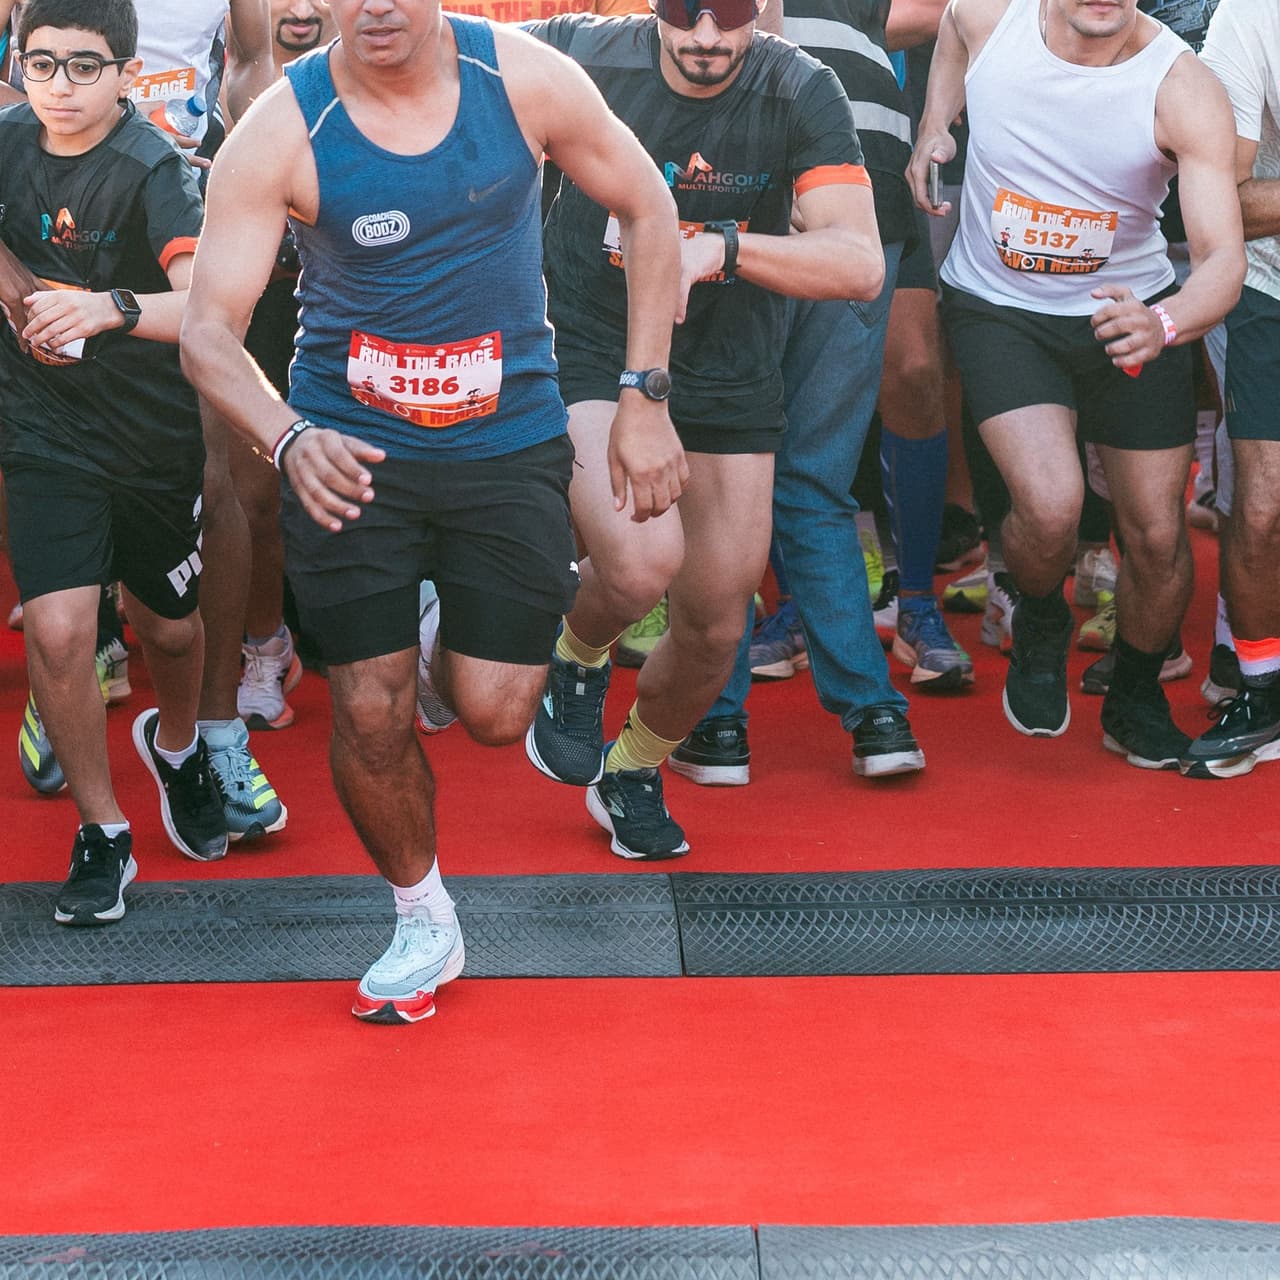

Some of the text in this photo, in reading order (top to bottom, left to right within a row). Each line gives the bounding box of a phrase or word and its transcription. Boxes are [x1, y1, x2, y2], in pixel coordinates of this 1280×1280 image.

[149, 78, 188, 99] RACE
[677, 183, 706, 192] MULTI
[1001, 200, 1111, 232] RUN THE RACE
[365, 220, 397, 239] BODZ
[1023, 228, 1079, 249] 5137
[359, 345, 495, 370] RUN THE RACE
[389, 375, 460, 396] 3186
